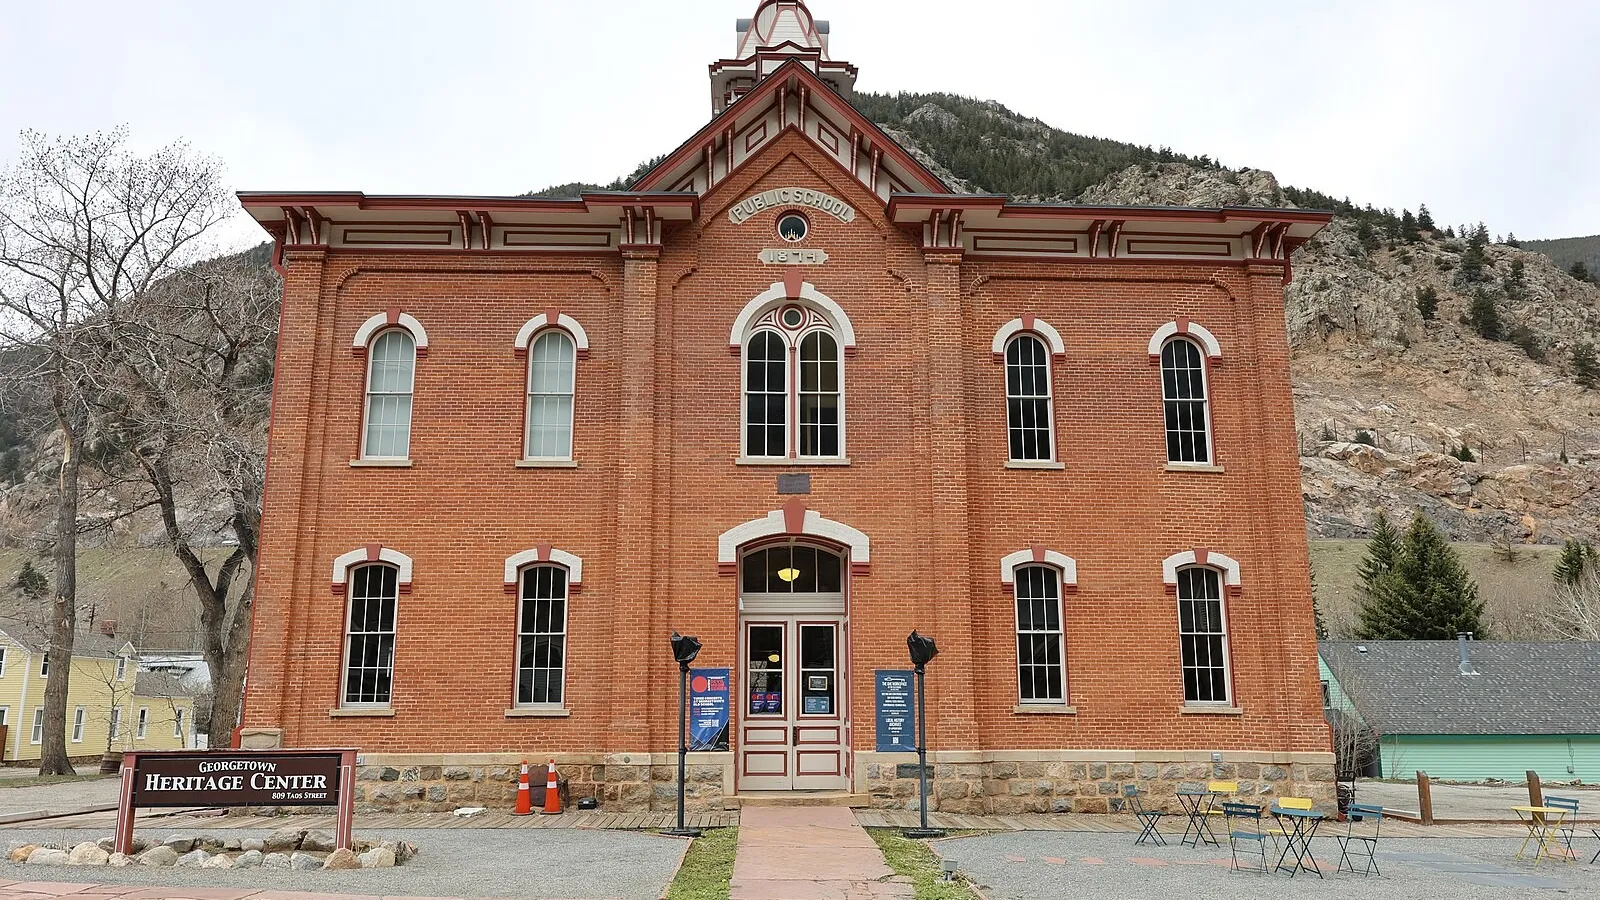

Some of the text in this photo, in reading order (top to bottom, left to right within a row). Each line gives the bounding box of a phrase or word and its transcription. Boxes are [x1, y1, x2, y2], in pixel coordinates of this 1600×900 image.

[732, 190, 849, 222] PUBLIC SCHOOL
[769, 251, 817, 263] 1874
[198, 760, 277, 773] GEORGETOWN
[144, 772, 327, 792] HERITAGE CENTER
[271, 792, 286, 800] 809
[303, 791, 328, 799] STREET
